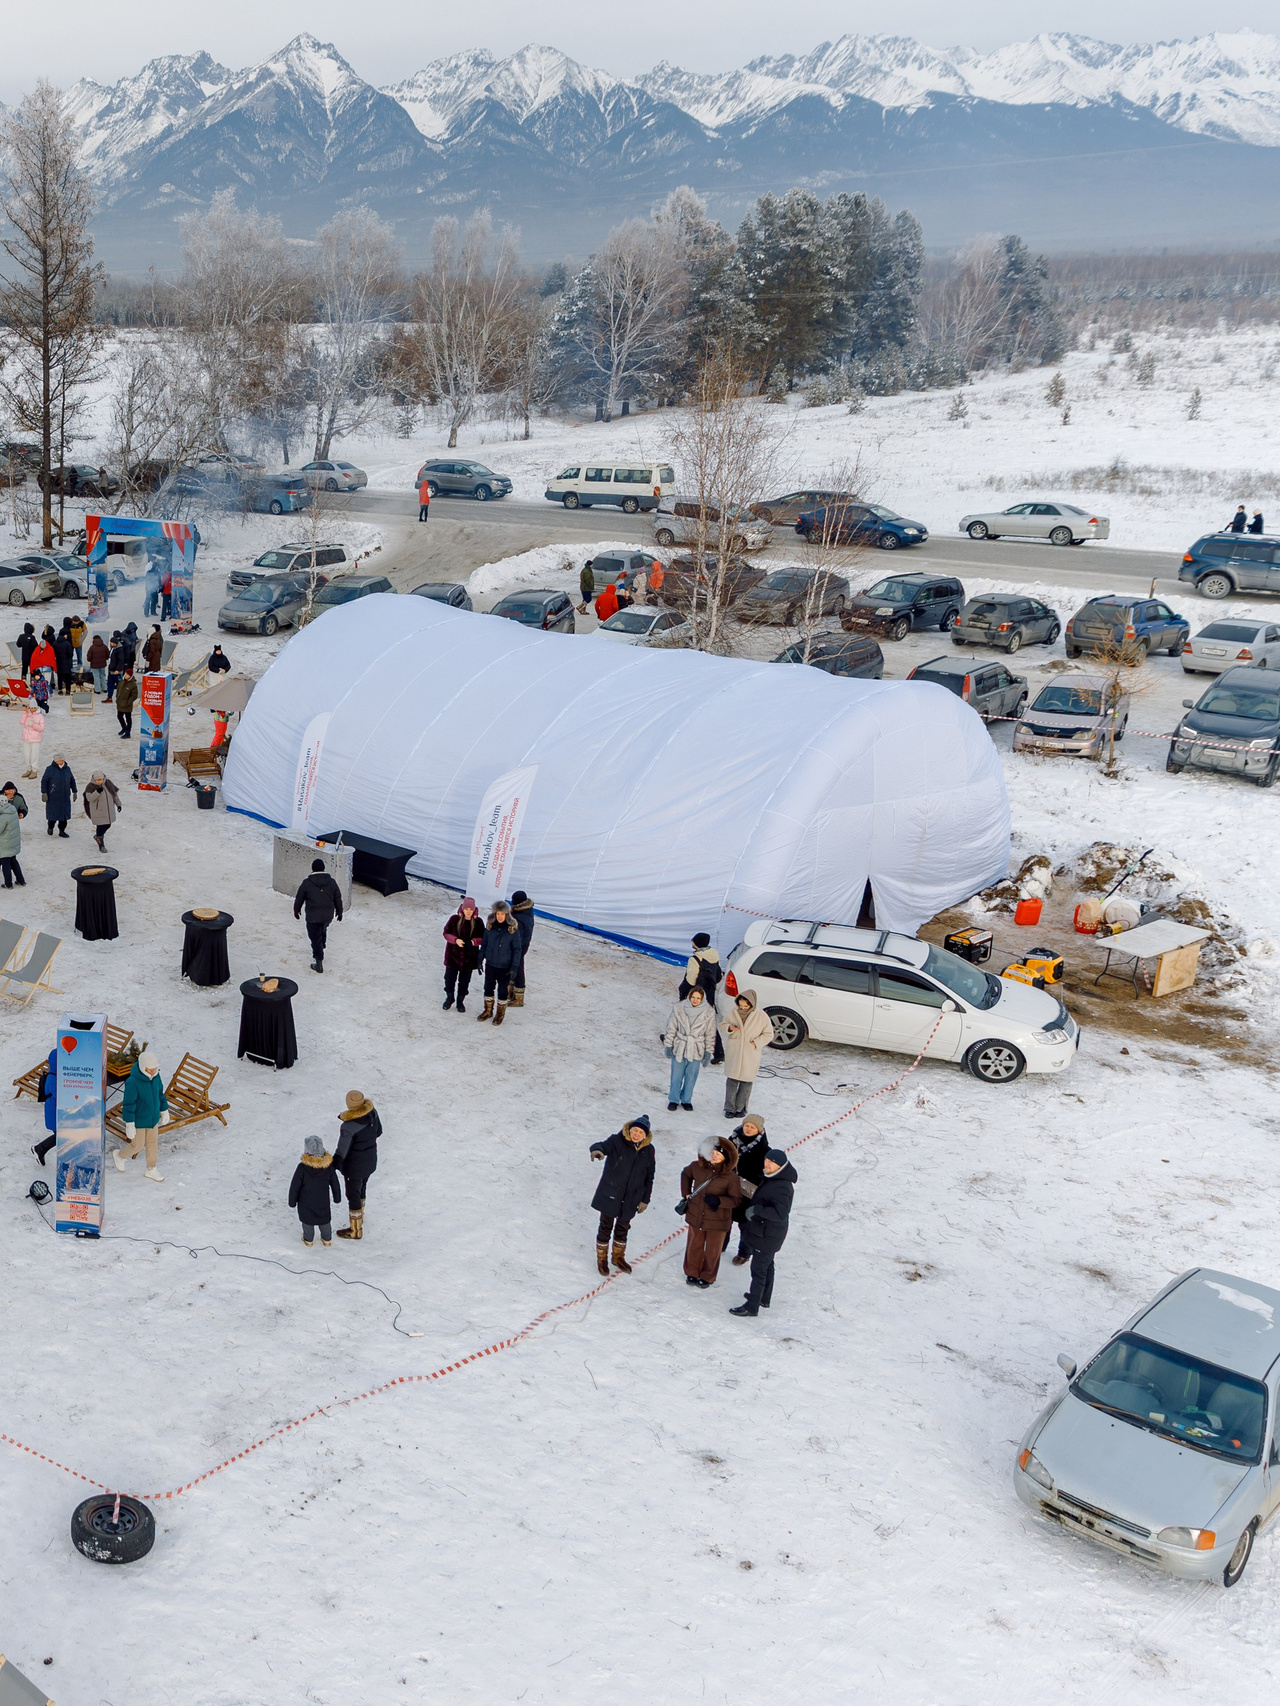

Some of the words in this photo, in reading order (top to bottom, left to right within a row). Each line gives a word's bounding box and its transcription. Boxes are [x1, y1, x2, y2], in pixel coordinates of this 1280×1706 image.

[478, 804, 501, 875] #Rusakov_team
[495, 863, 504, 888] КОТОРЫЕ
[500, 828, 511, 862] СТАНОВЯТСЯ
[508, 797, 520, 827] ИСТОРИЕЙ
